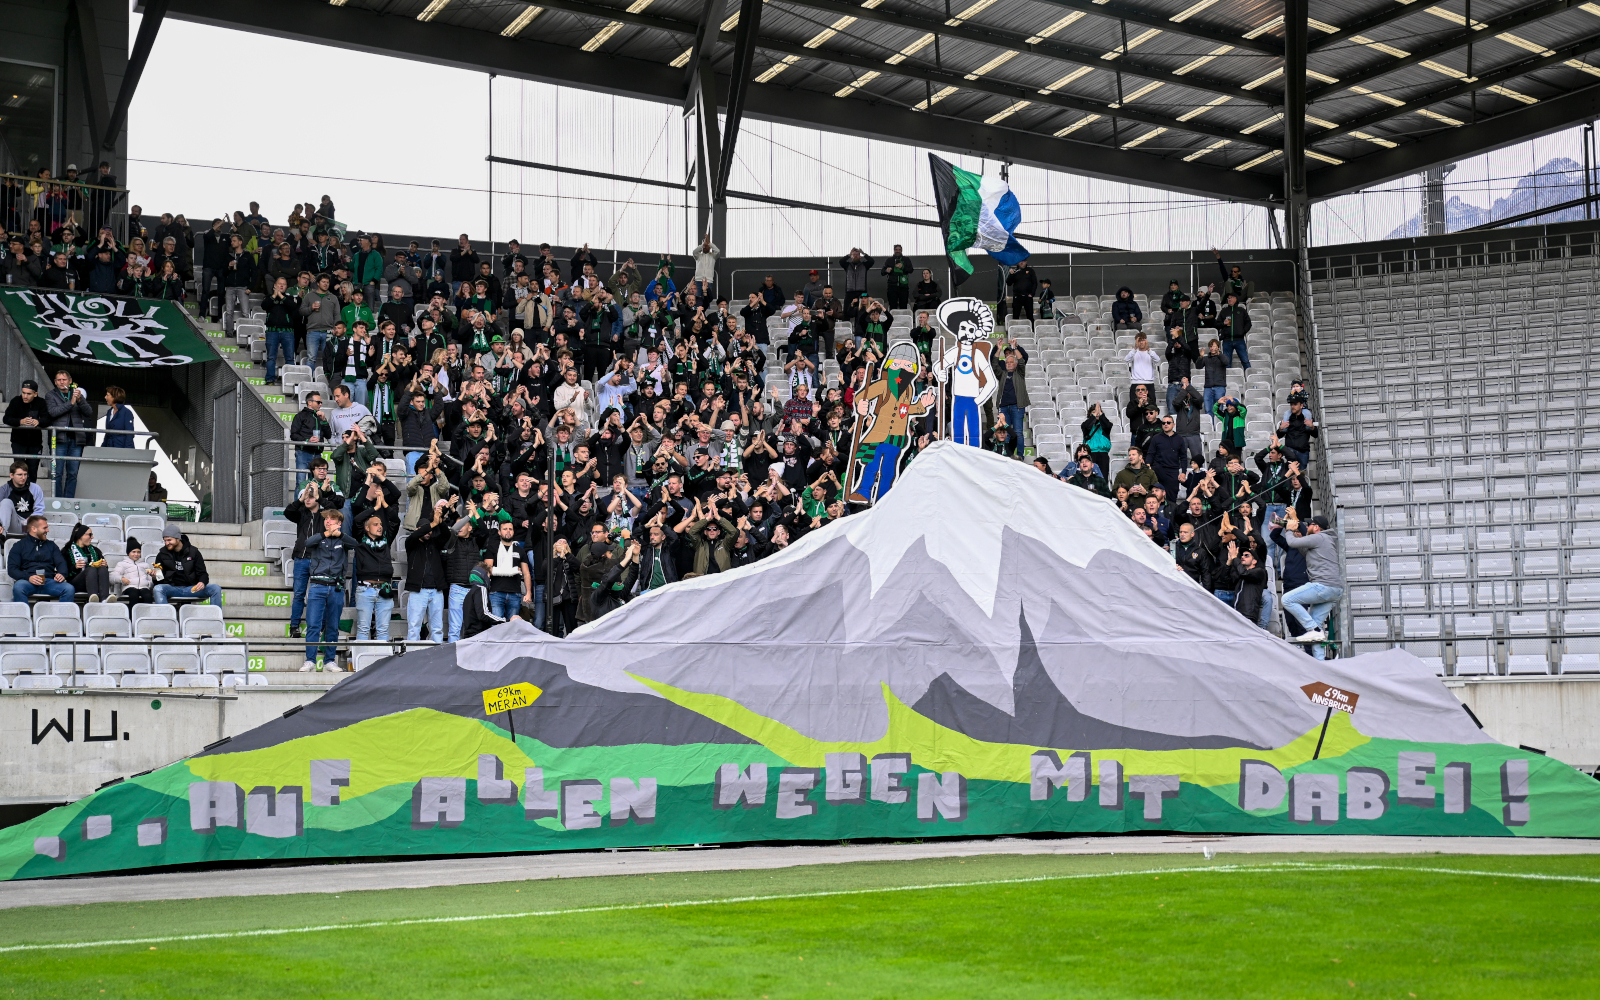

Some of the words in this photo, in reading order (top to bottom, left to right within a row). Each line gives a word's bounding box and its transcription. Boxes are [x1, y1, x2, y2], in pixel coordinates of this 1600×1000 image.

[5, 290, 160, 318] TIVOLI
[243, 565, 265, 576] B06
[266, 595, 288, 606] B05
[227, 624, 243, 635] 04
[247, 658, 264, 669] 03
[497, 687, 521, 699] 69km
[1324, 688, 1349, 703] 69km
[488, 695, 527, 713] MERAN
[1311, 692, 1354, 714] INNSBRUCK
[411, 754, 658, 830] ALLEN
[713, 752, 967, 823] WEGEN
[1030, 749, 1180, 824] MIT
